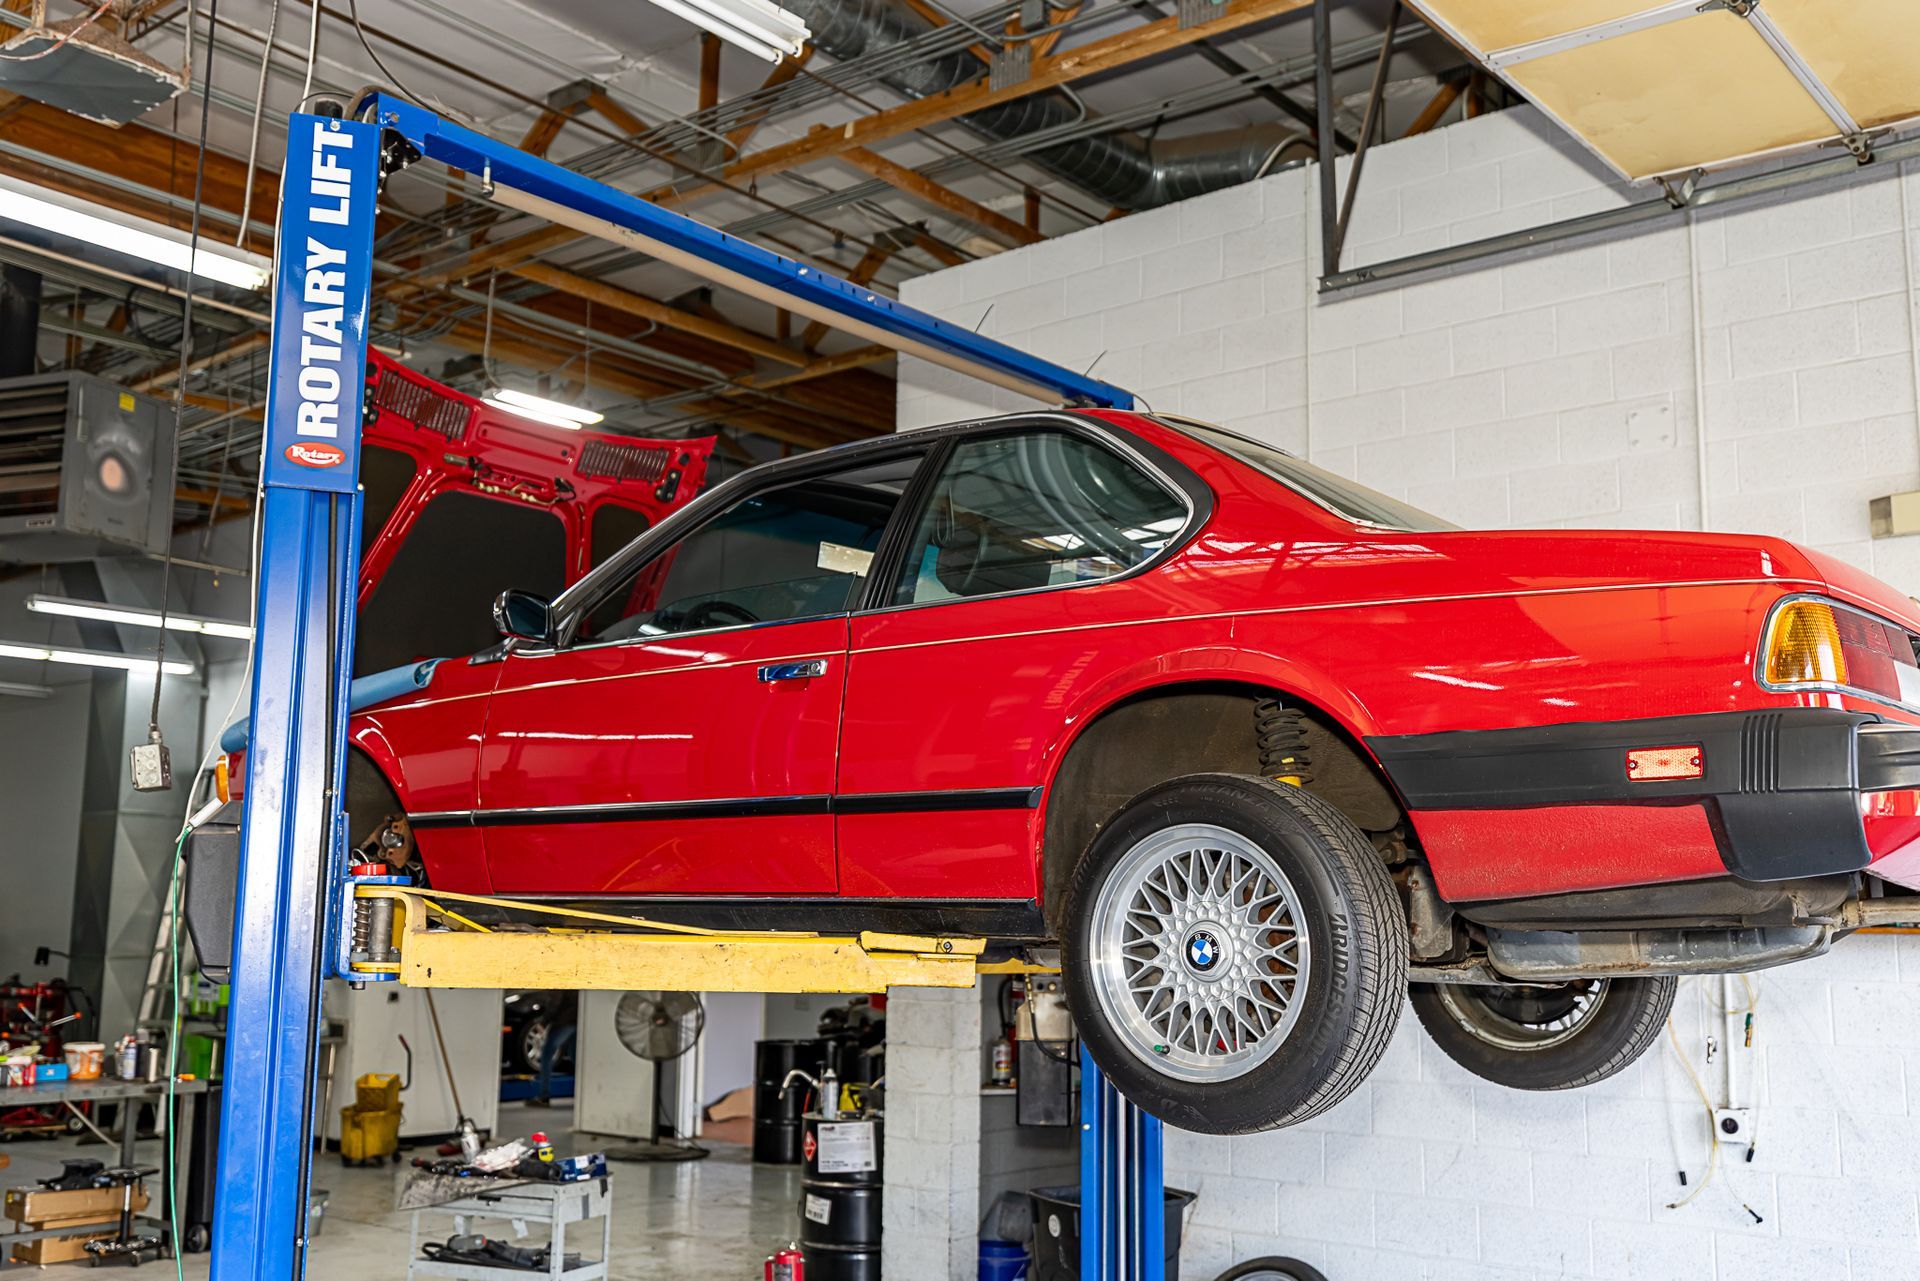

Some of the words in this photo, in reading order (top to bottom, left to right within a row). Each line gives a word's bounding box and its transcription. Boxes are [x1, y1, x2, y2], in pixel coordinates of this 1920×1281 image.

[309, 121, 354, 226] LIFT
[296, 236, 347, 438] ROTARY
[291, 445, 341, 464] Rotary
[1194, 933, 1219, 954] BMW
